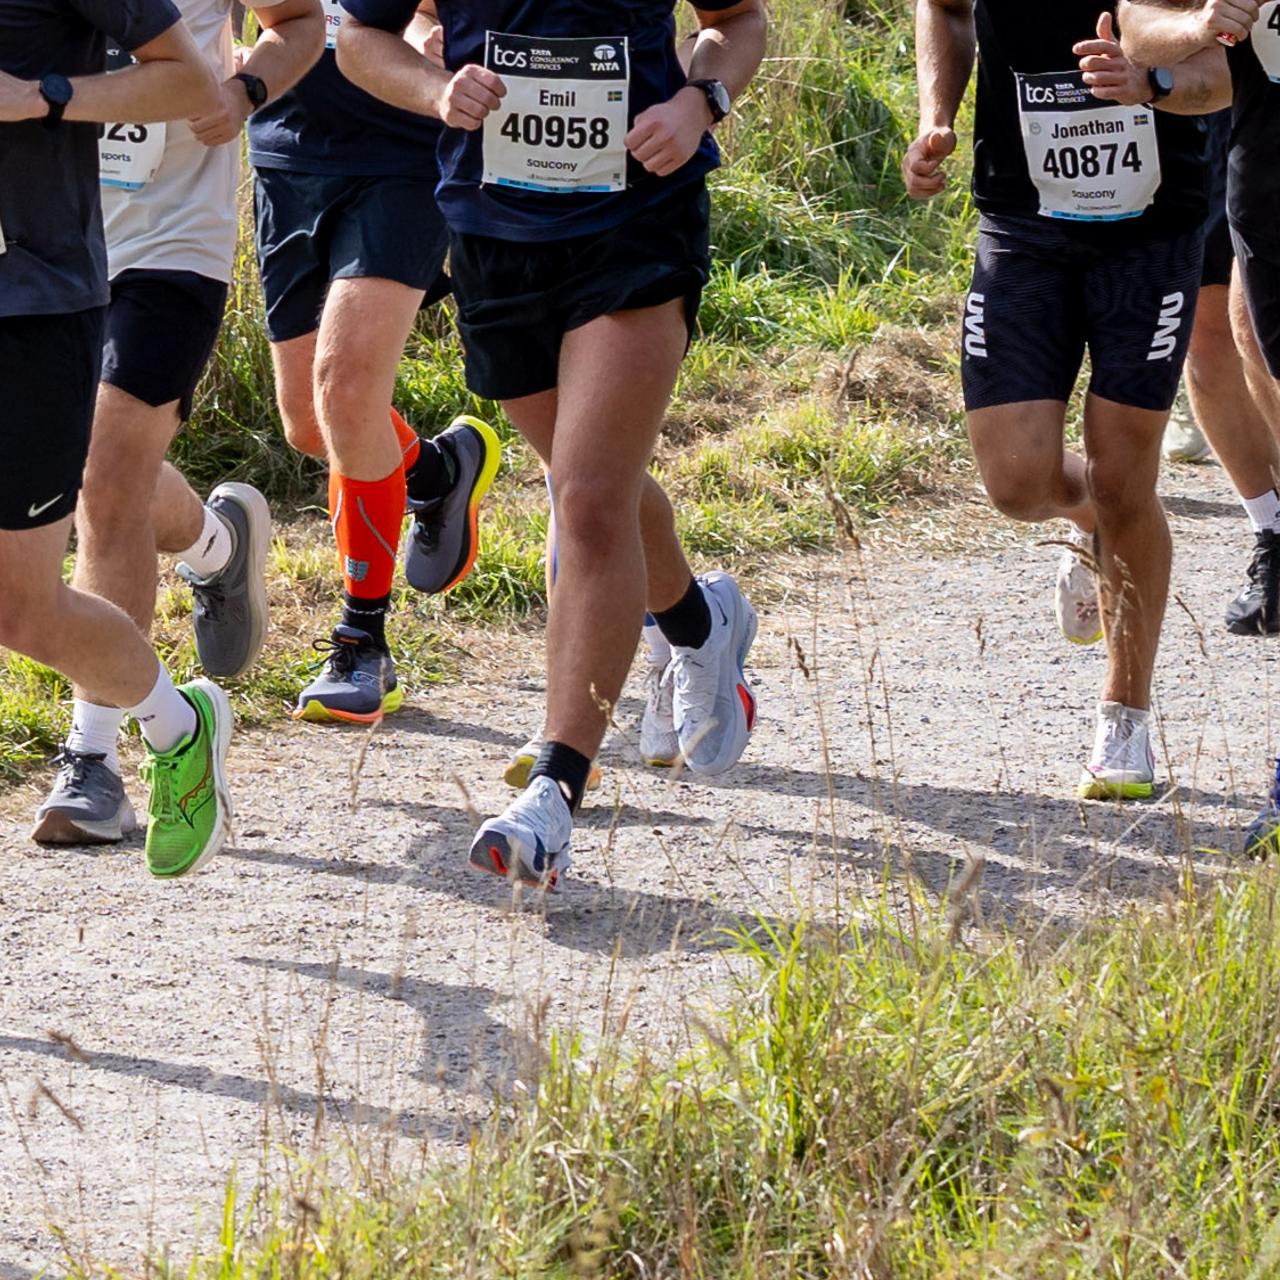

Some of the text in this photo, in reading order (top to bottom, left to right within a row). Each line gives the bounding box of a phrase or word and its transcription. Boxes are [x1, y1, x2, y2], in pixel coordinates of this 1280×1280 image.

[494, 44, 527, 67] tcs
[529, 56, 580, 64] CONSULTANCY
[590, 62, 620, 71] TATA
[539, 89, 576, 107] Emil
[1025, 83, 1055, 103] tcs
[500, 112, 610, 150] 40958
[1051, 120, 1124, 139] Jonathan
[527, 159, 578, 172] saucony
[1043, 141, 1142, 179] 40874
[1072, 189, 1116, 199] saucony
[965, 292, 988, 358] UVU
[1146, 291, 1184, 361] UVU
